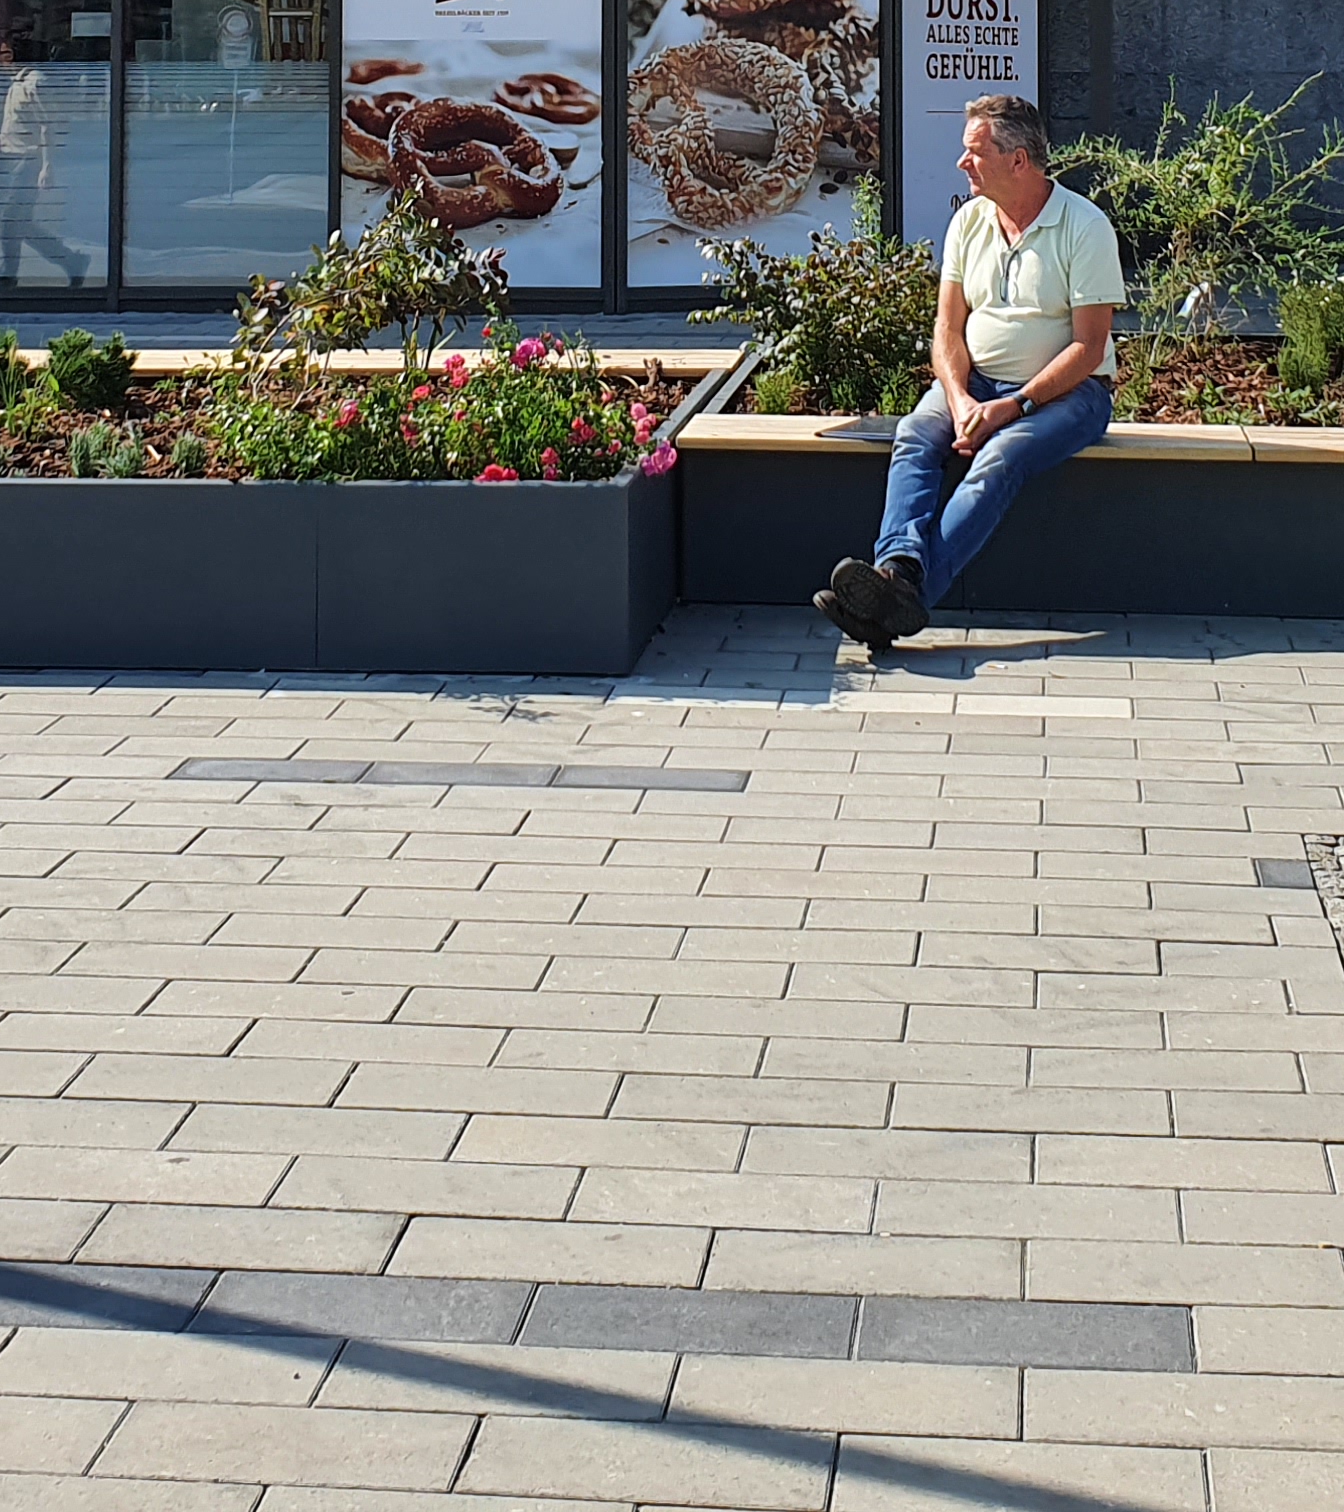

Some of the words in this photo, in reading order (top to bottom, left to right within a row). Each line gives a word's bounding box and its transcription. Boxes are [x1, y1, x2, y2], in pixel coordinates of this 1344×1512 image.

[926, 24, 970, 44] ALLES
[974, 26, 1019, 46] ECHTE
[926, 47, 1019, 81] GEFÜHLE.
